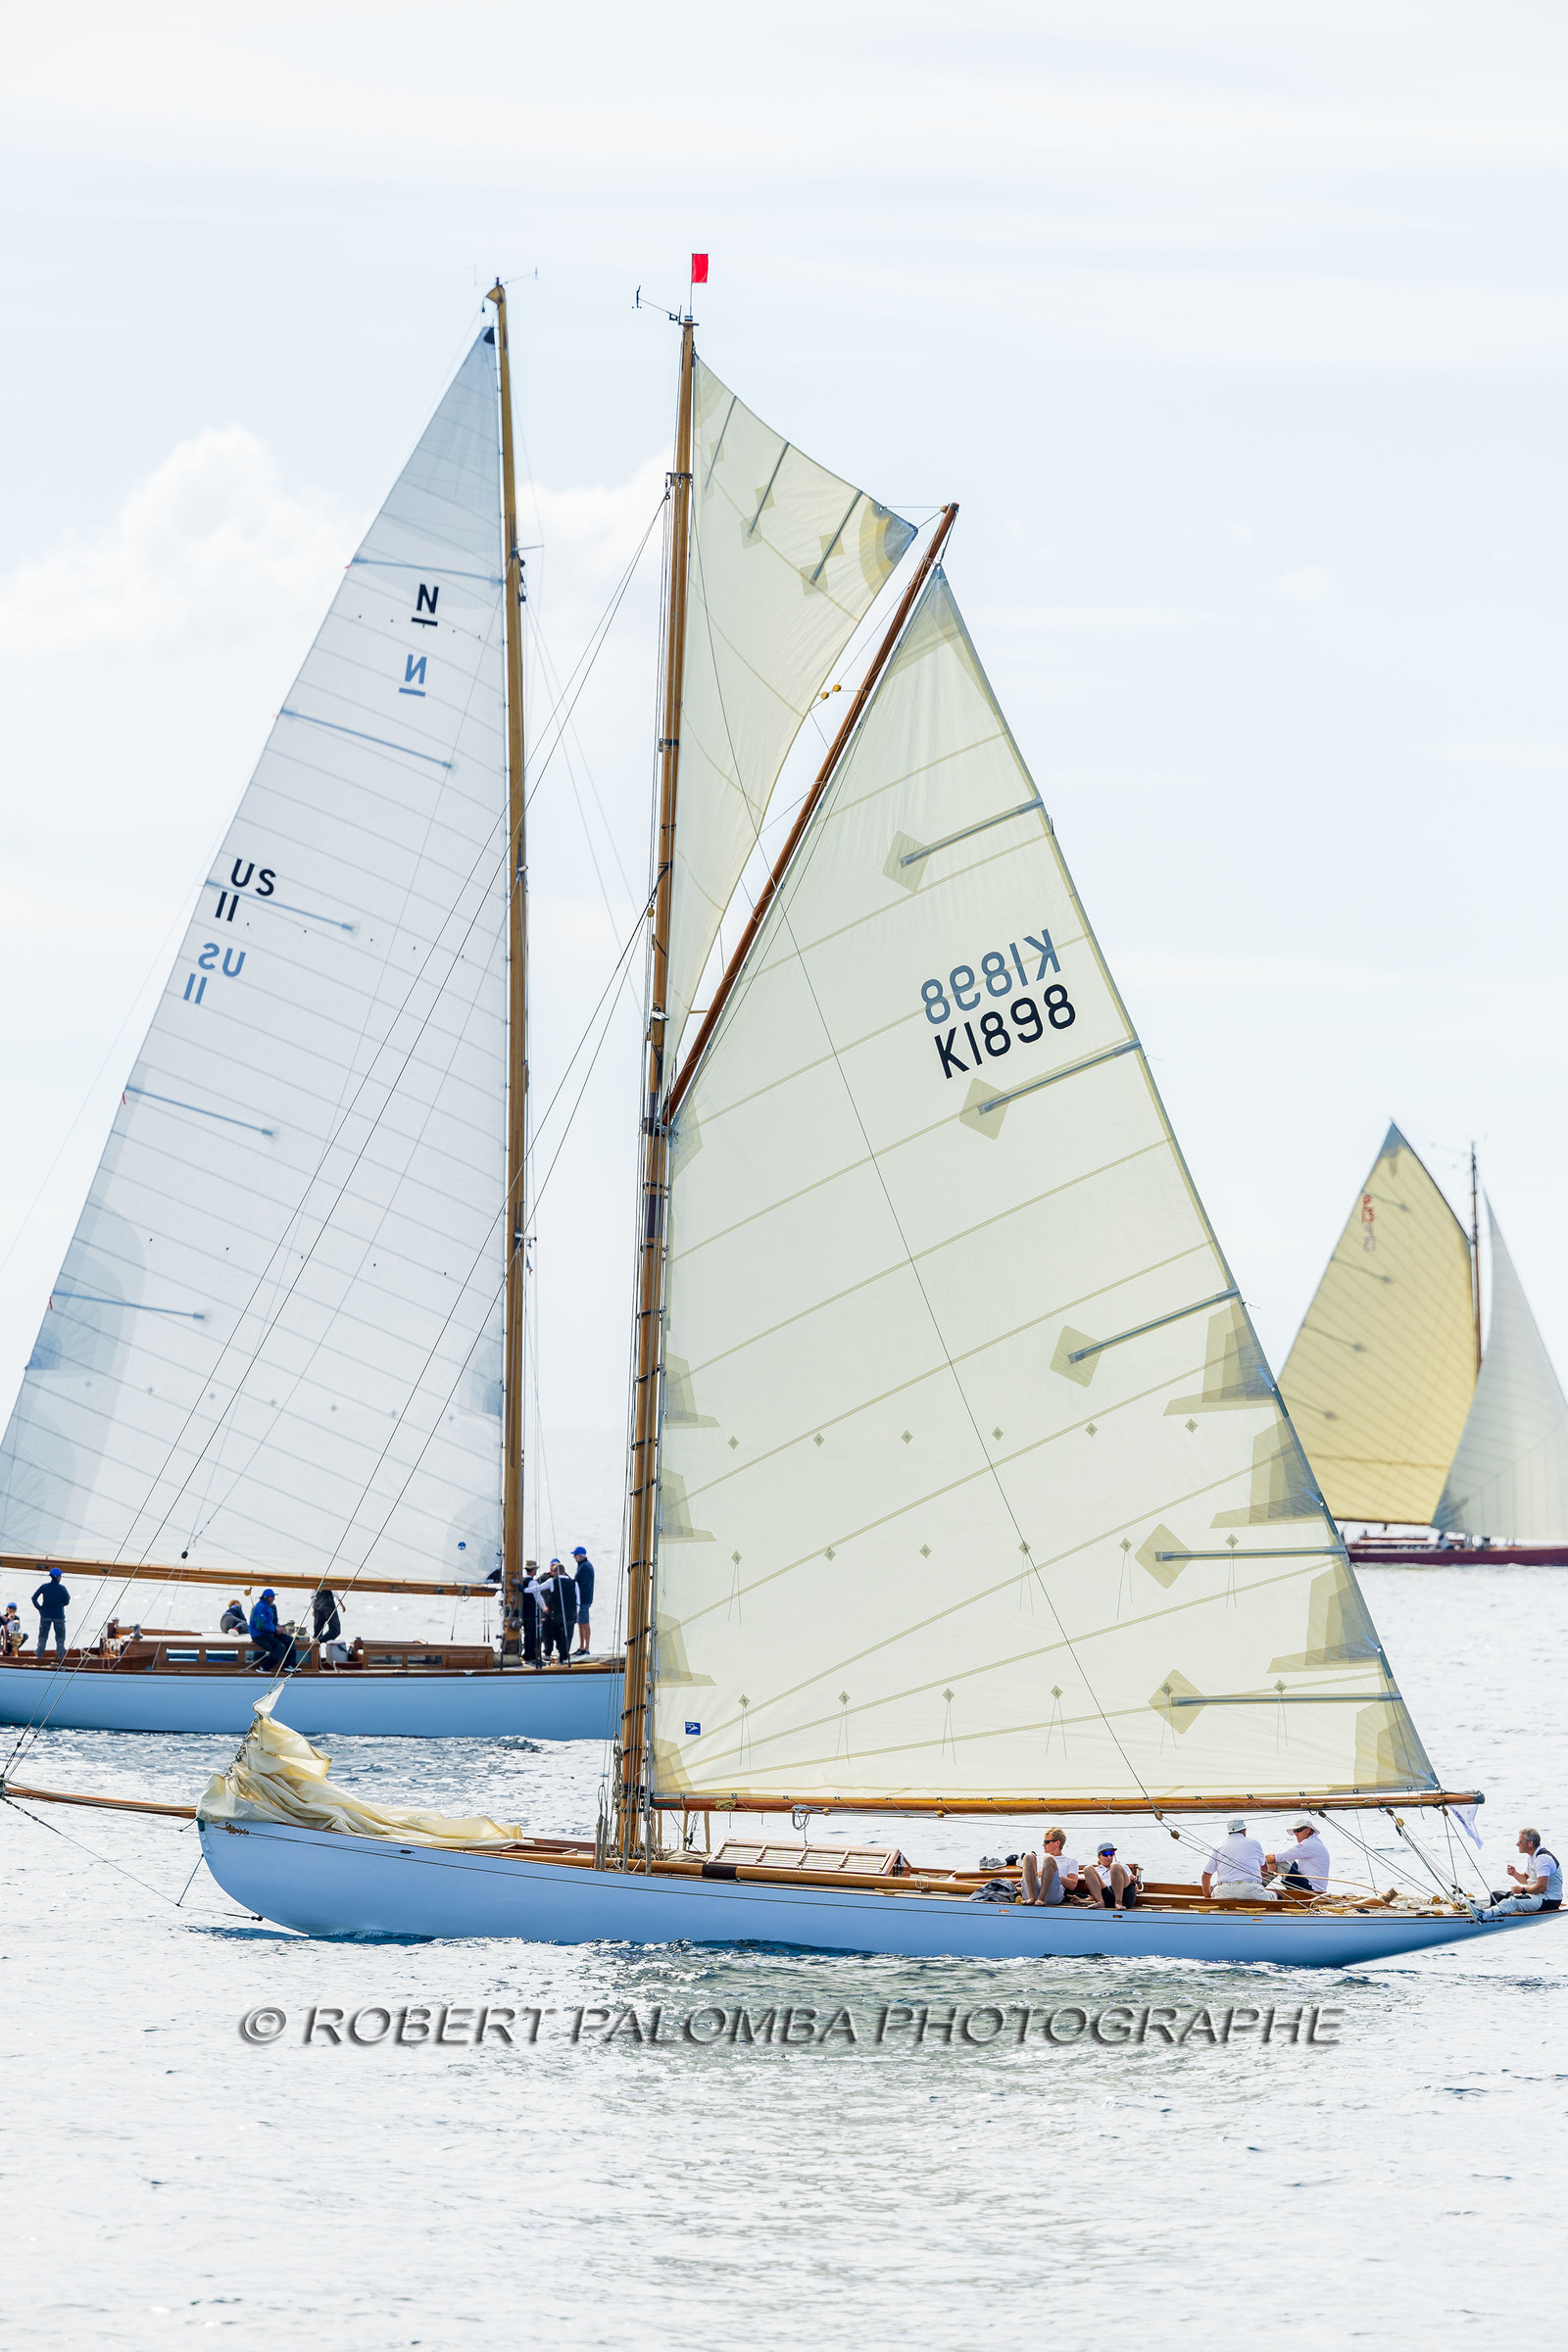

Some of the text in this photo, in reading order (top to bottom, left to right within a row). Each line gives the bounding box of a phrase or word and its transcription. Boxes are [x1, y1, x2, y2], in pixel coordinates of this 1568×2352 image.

[416, 584, 439, 614] N
[230, 858, 276, 896] US
[215, 891, 240, 922] 11
[934, 983, 1076, 1080] K1898
